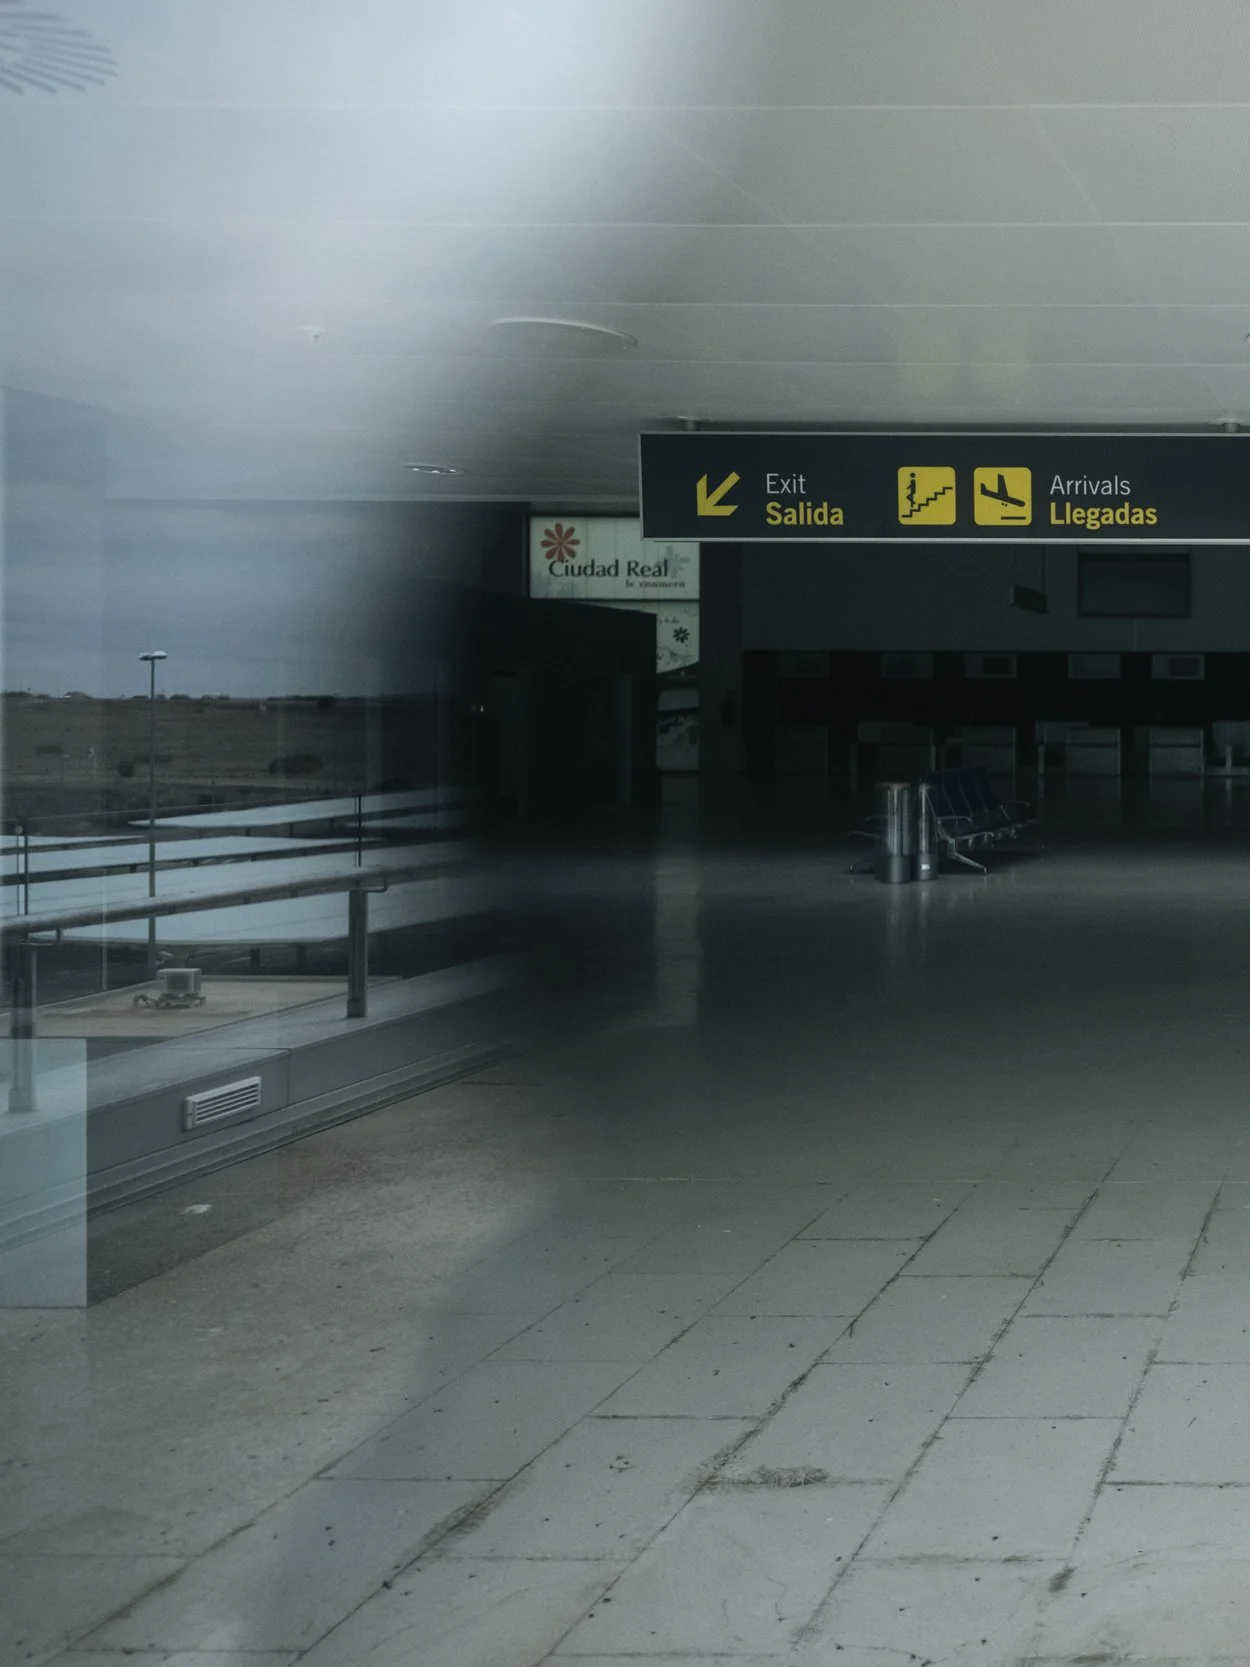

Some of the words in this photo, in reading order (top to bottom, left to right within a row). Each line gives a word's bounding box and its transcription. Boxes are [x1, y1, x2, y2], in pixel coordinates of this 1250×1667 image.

[766, 473, 807, 494] Exit
[1049, 474, 1131, 496] Arrivals
[766, 501, 844, 526] Salida
[1050, 501, 1158, 530] Llegadas
[548, 559, 619, 577] Ciudad
[627, 559, 668, 577] Real
